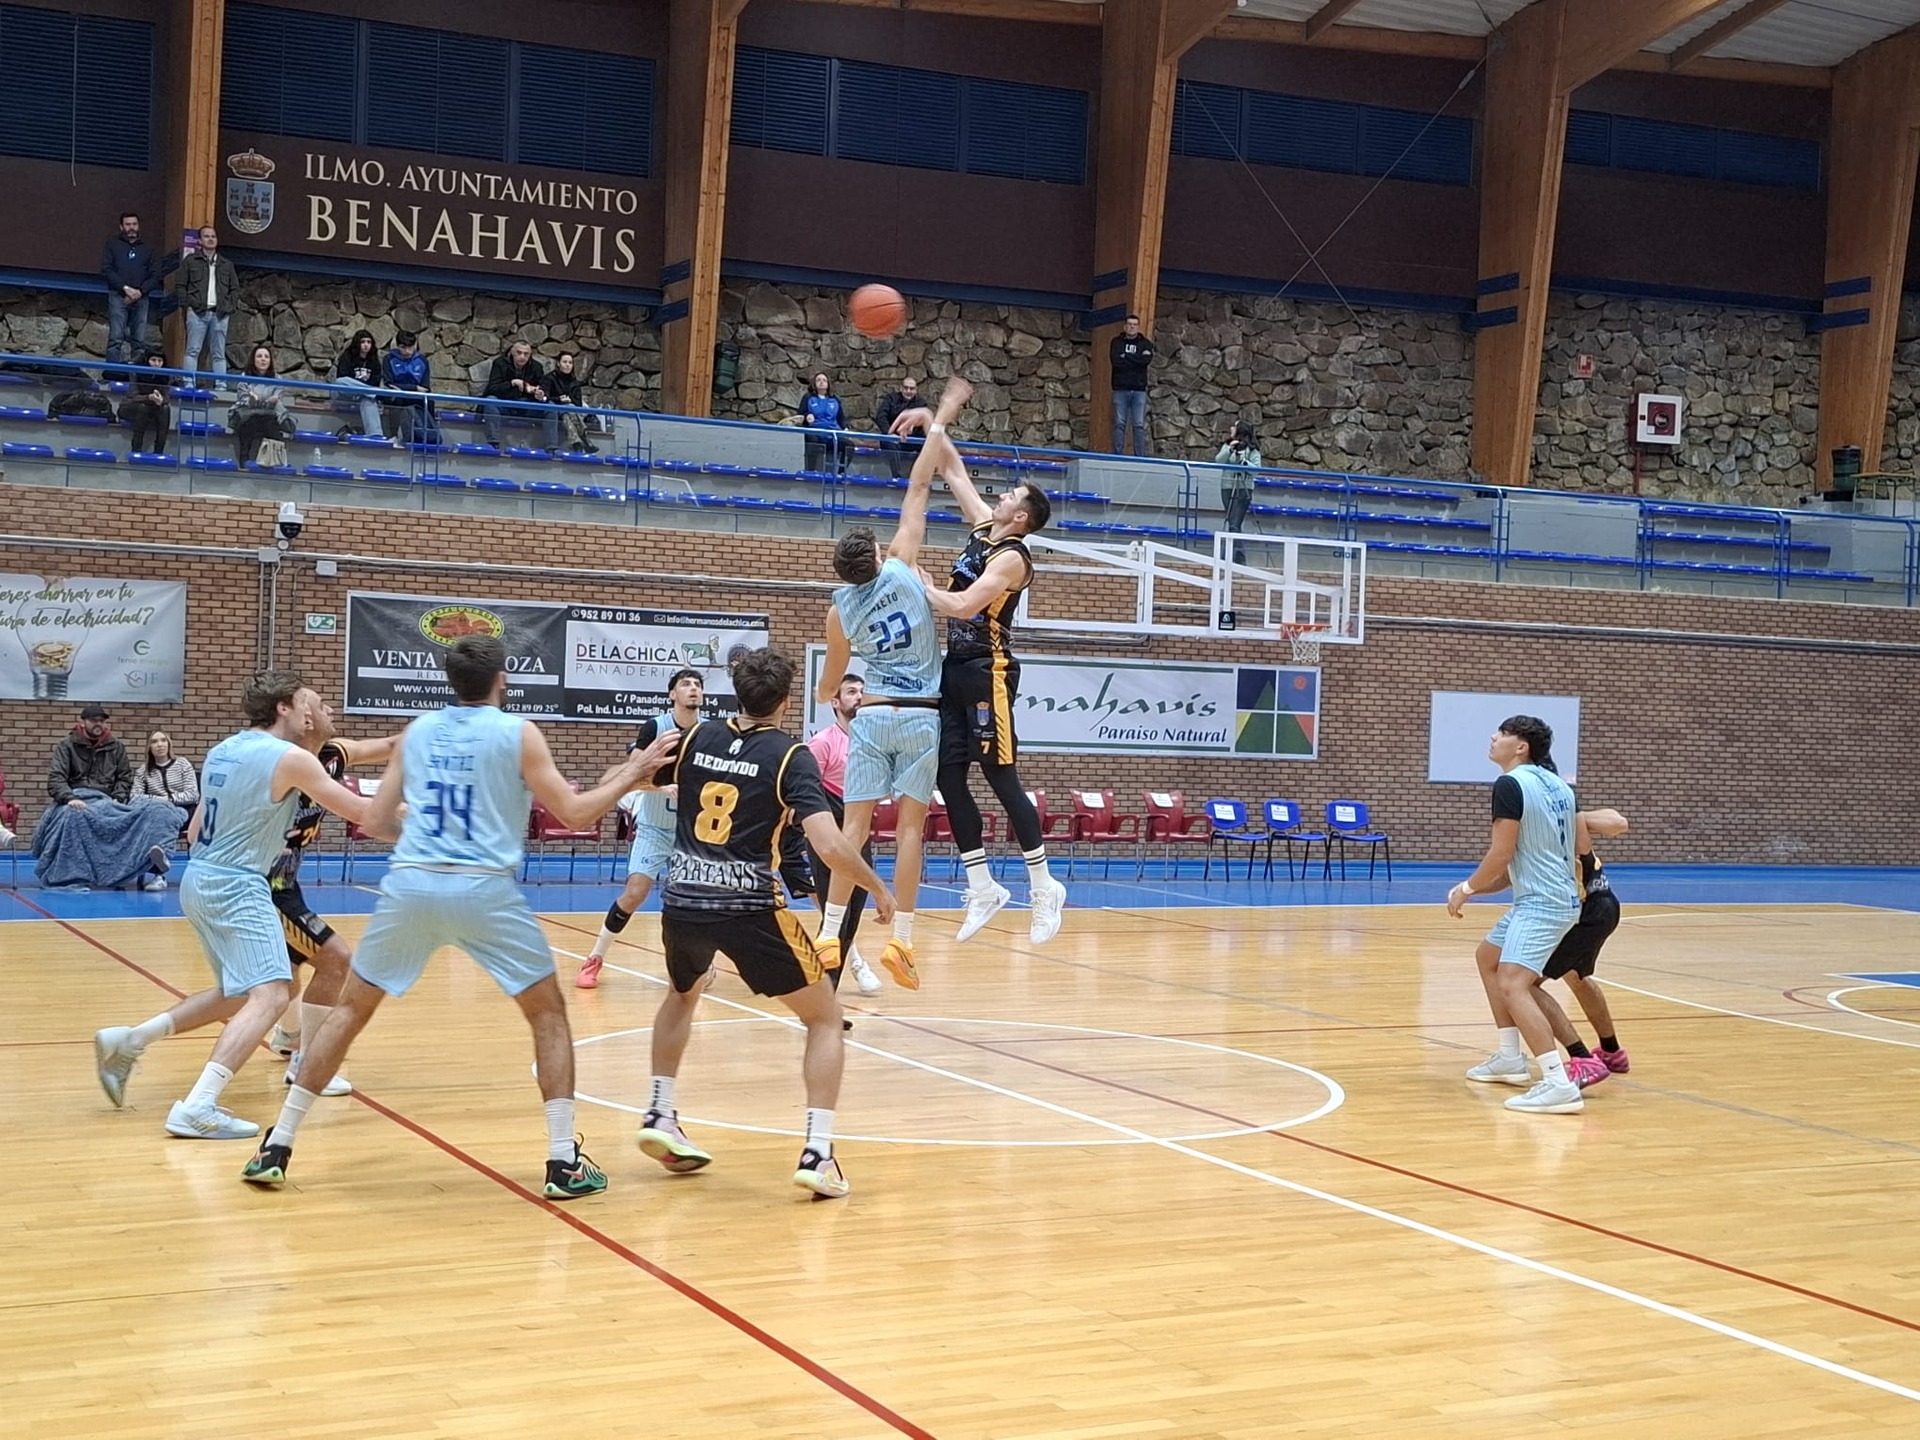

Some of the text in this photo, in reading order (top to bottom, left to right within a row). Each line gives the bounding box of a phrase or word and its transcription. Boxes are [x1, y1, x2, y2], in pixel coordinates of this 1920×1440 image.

[304, 153, 638, 215] ILMO. AYUNTAMIENTO
[306, 194, 636, 273] BENAHAVIS
[0, 582, 135, 604] eres ahorrar en tu
[31, 609, 51, 627] de
[54, 606, 155, 630] electricidad?
[580, 609, 641, 622] 952 89 01 36
[868, 611, 913, 655] 23
[372, 649, 438, 669] VENTA
[504, 655, 546, 673] OZA
[576, 643, 680, 662] DE LA CHICA
[575, 662, 677, 678] PANADERIA
[356, 698, 371, 707] A-7
[374, 698, 390, 707] KM
[391, 699, 405, 708] 146
[506, 703, 520, 712] 952
[521, 704, 532, 712] 89
[532, 704, 544, 713] 09
[595, 705, 611, 715] Ind.
[612, 706, 624, 715] La
[705, 697, 718, 707] 1-6
[1098, 725, 1228, 742] Paraiso Natural
[980, 741, 991, 754] 7
[693, 752, 760, 778] REDONDO
[421, 781, 474, 841] 34
[694, 781, 740, 846] 8
[668, 850, 759, 891] PARTANS
